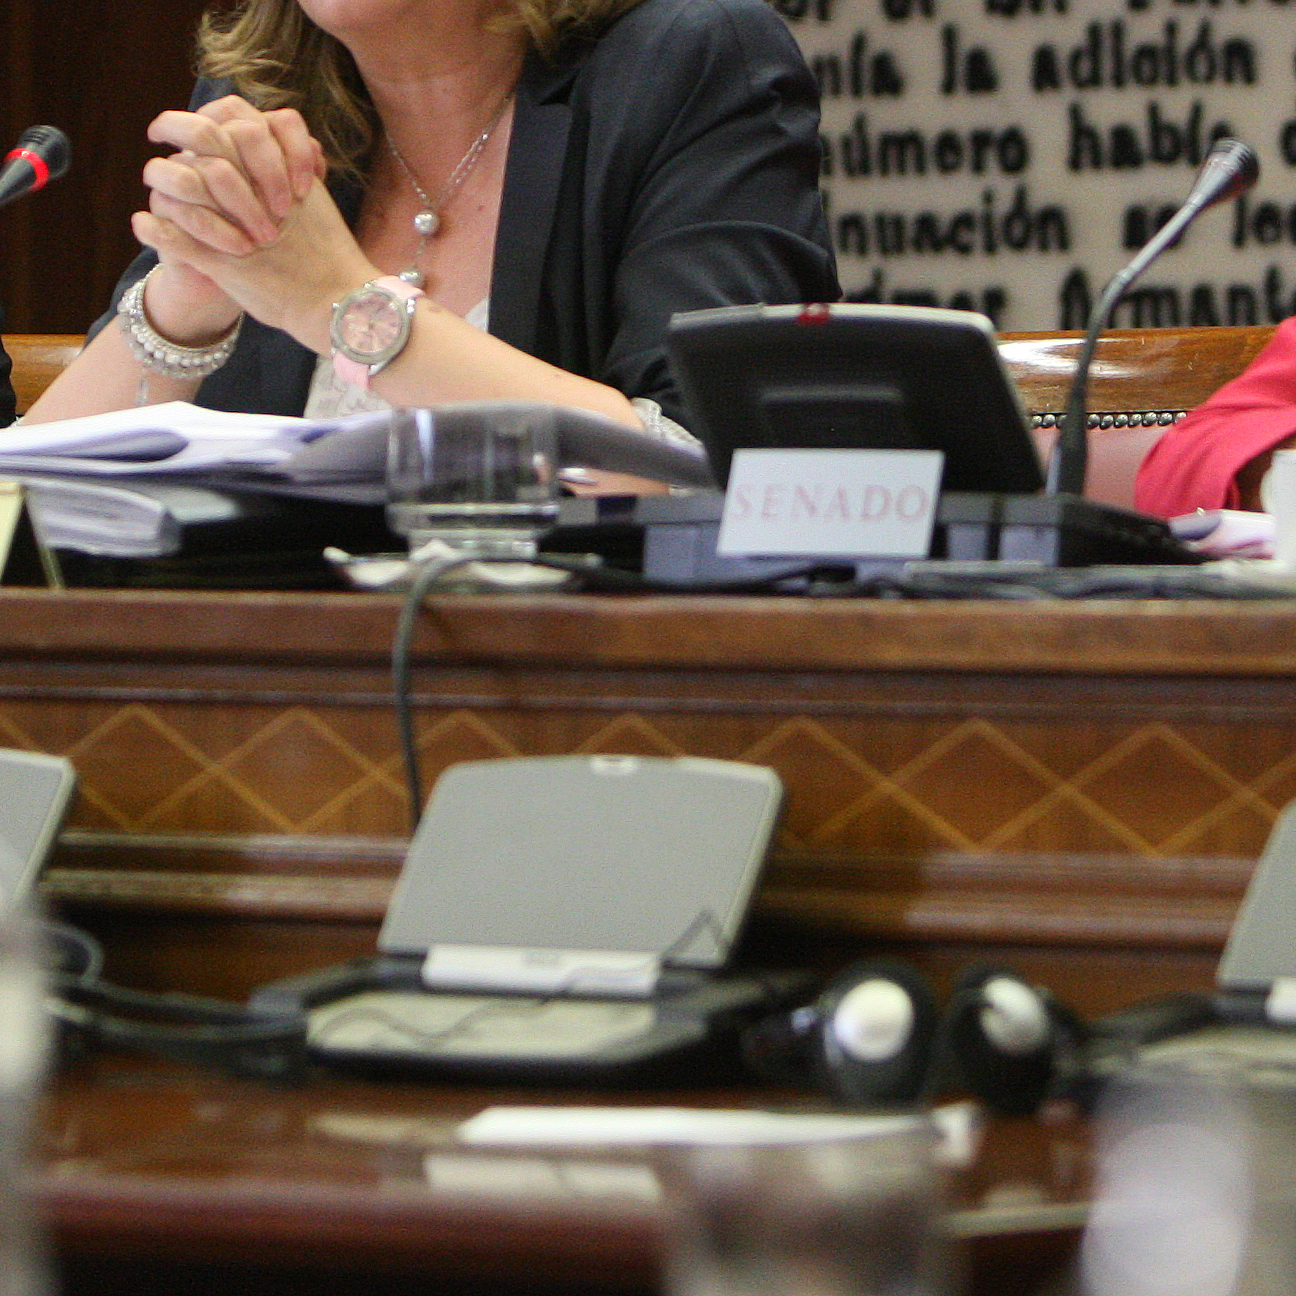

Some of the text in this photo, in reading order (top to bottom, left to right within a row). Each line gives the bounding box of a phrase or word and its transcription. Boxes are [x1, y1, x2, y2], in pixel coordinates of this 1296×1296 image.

[942, 22, 998, 95] la
[1032, 16, 1260, 92] adición
[820, 182, 1072, 258] nuación
[731, 482, 931, 522] SENADO
